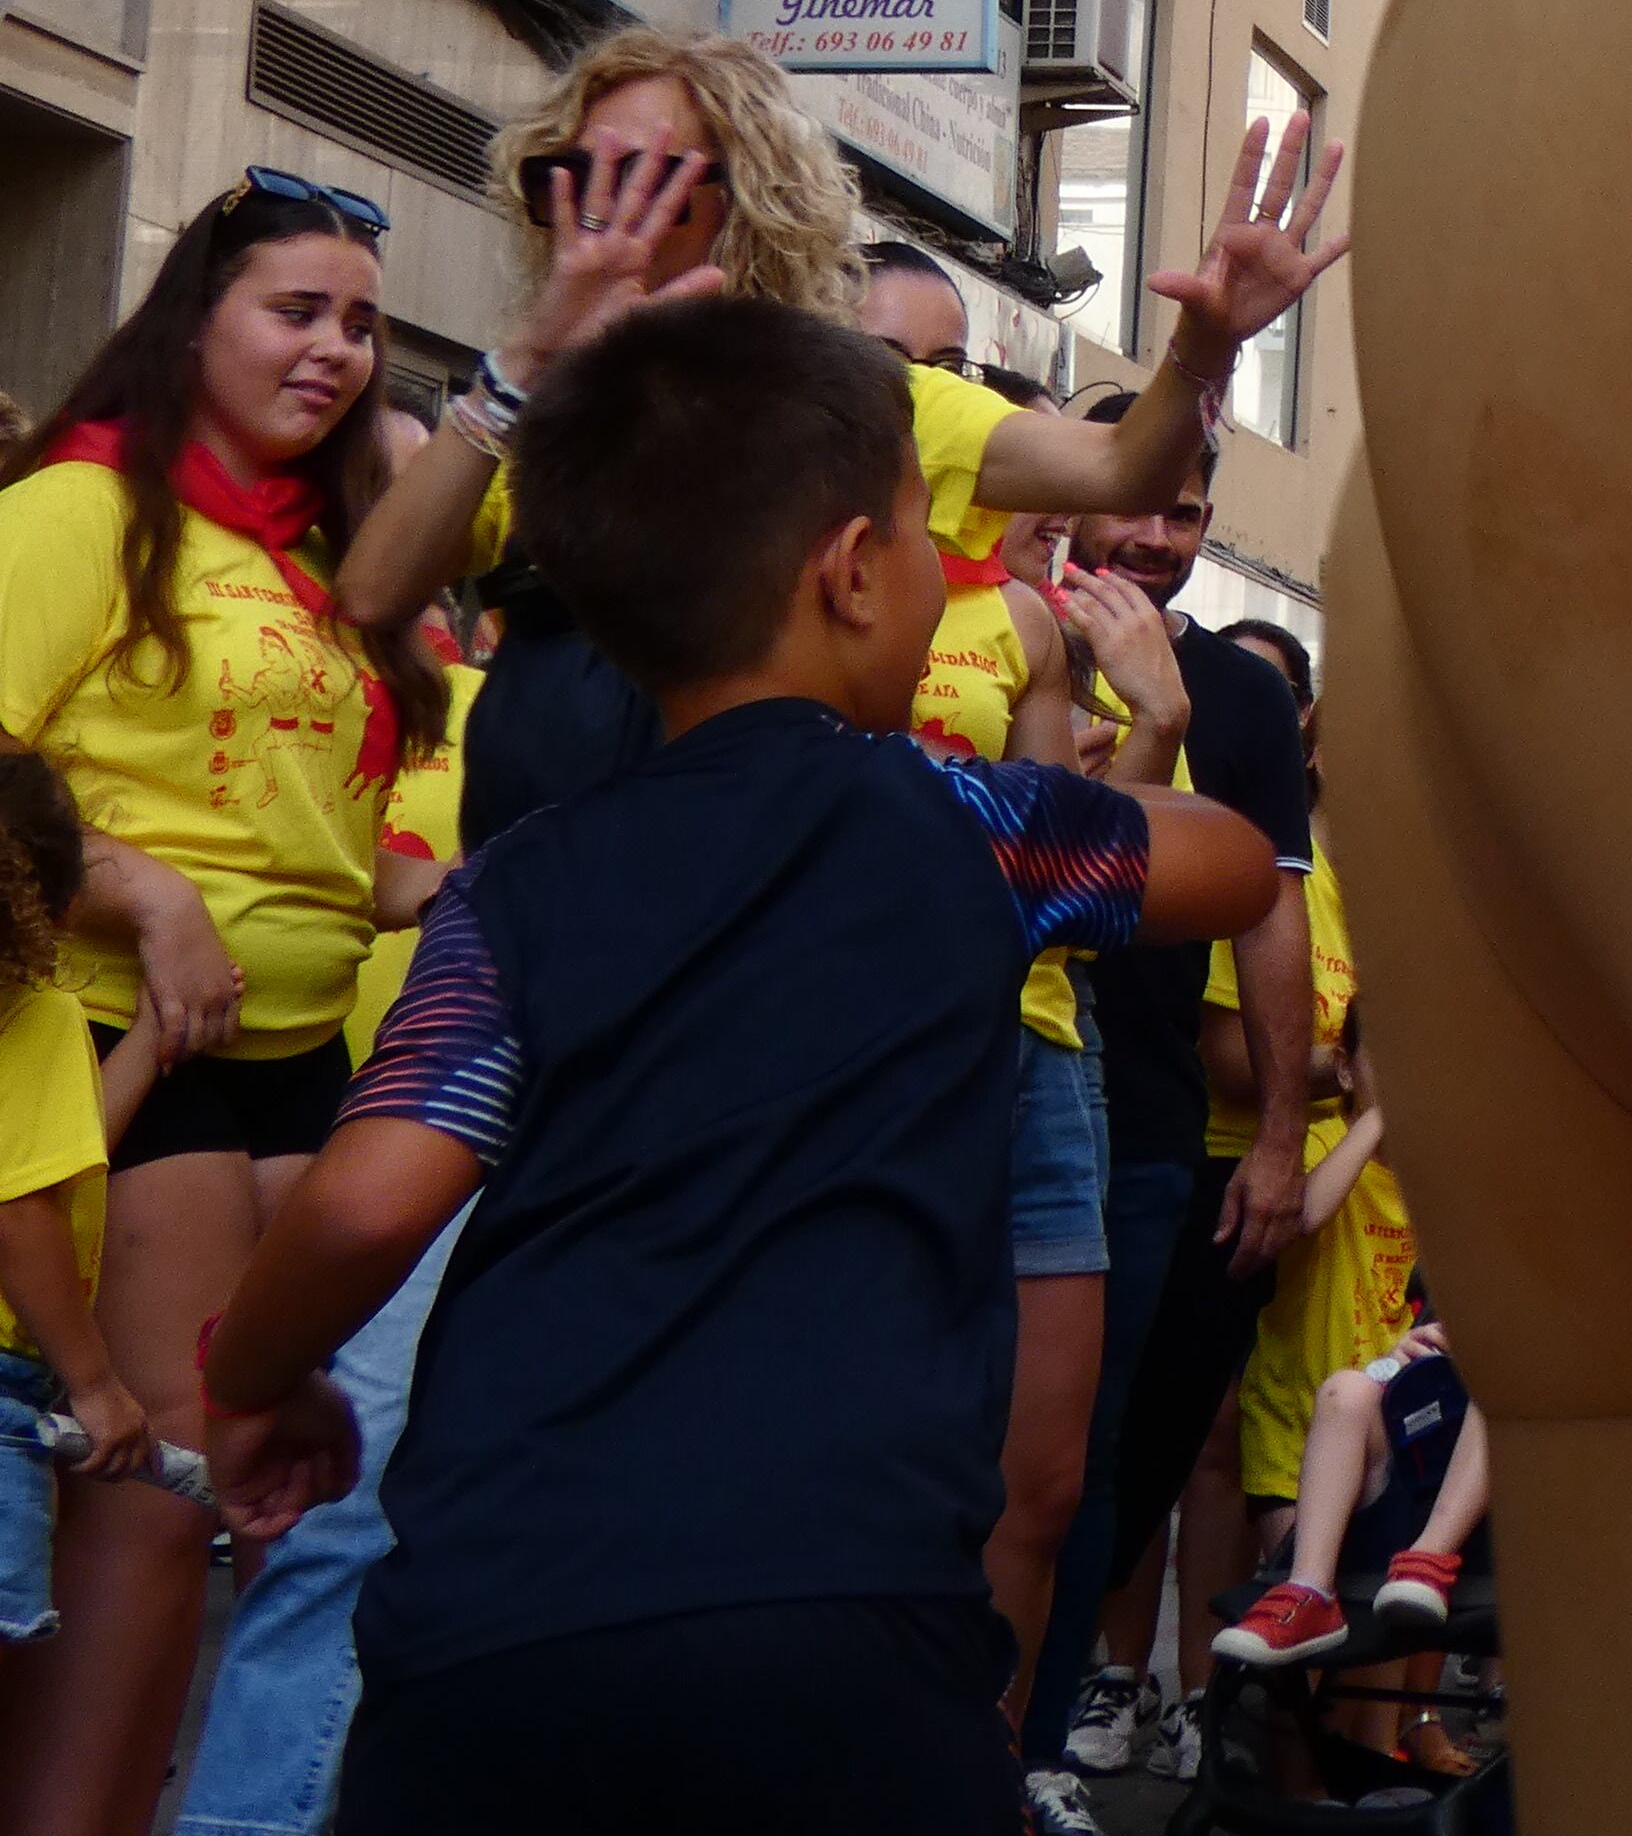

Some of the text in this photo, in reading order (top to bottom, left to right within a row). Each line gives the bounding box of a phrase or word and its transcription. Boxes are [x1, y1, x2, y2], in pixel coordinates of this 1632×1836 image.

[815, 30, 858, 53] 693
[866, 31, 895, 52] 06
[902, 30, 933, 53] 49
[940, 30, 969, 52] 81
